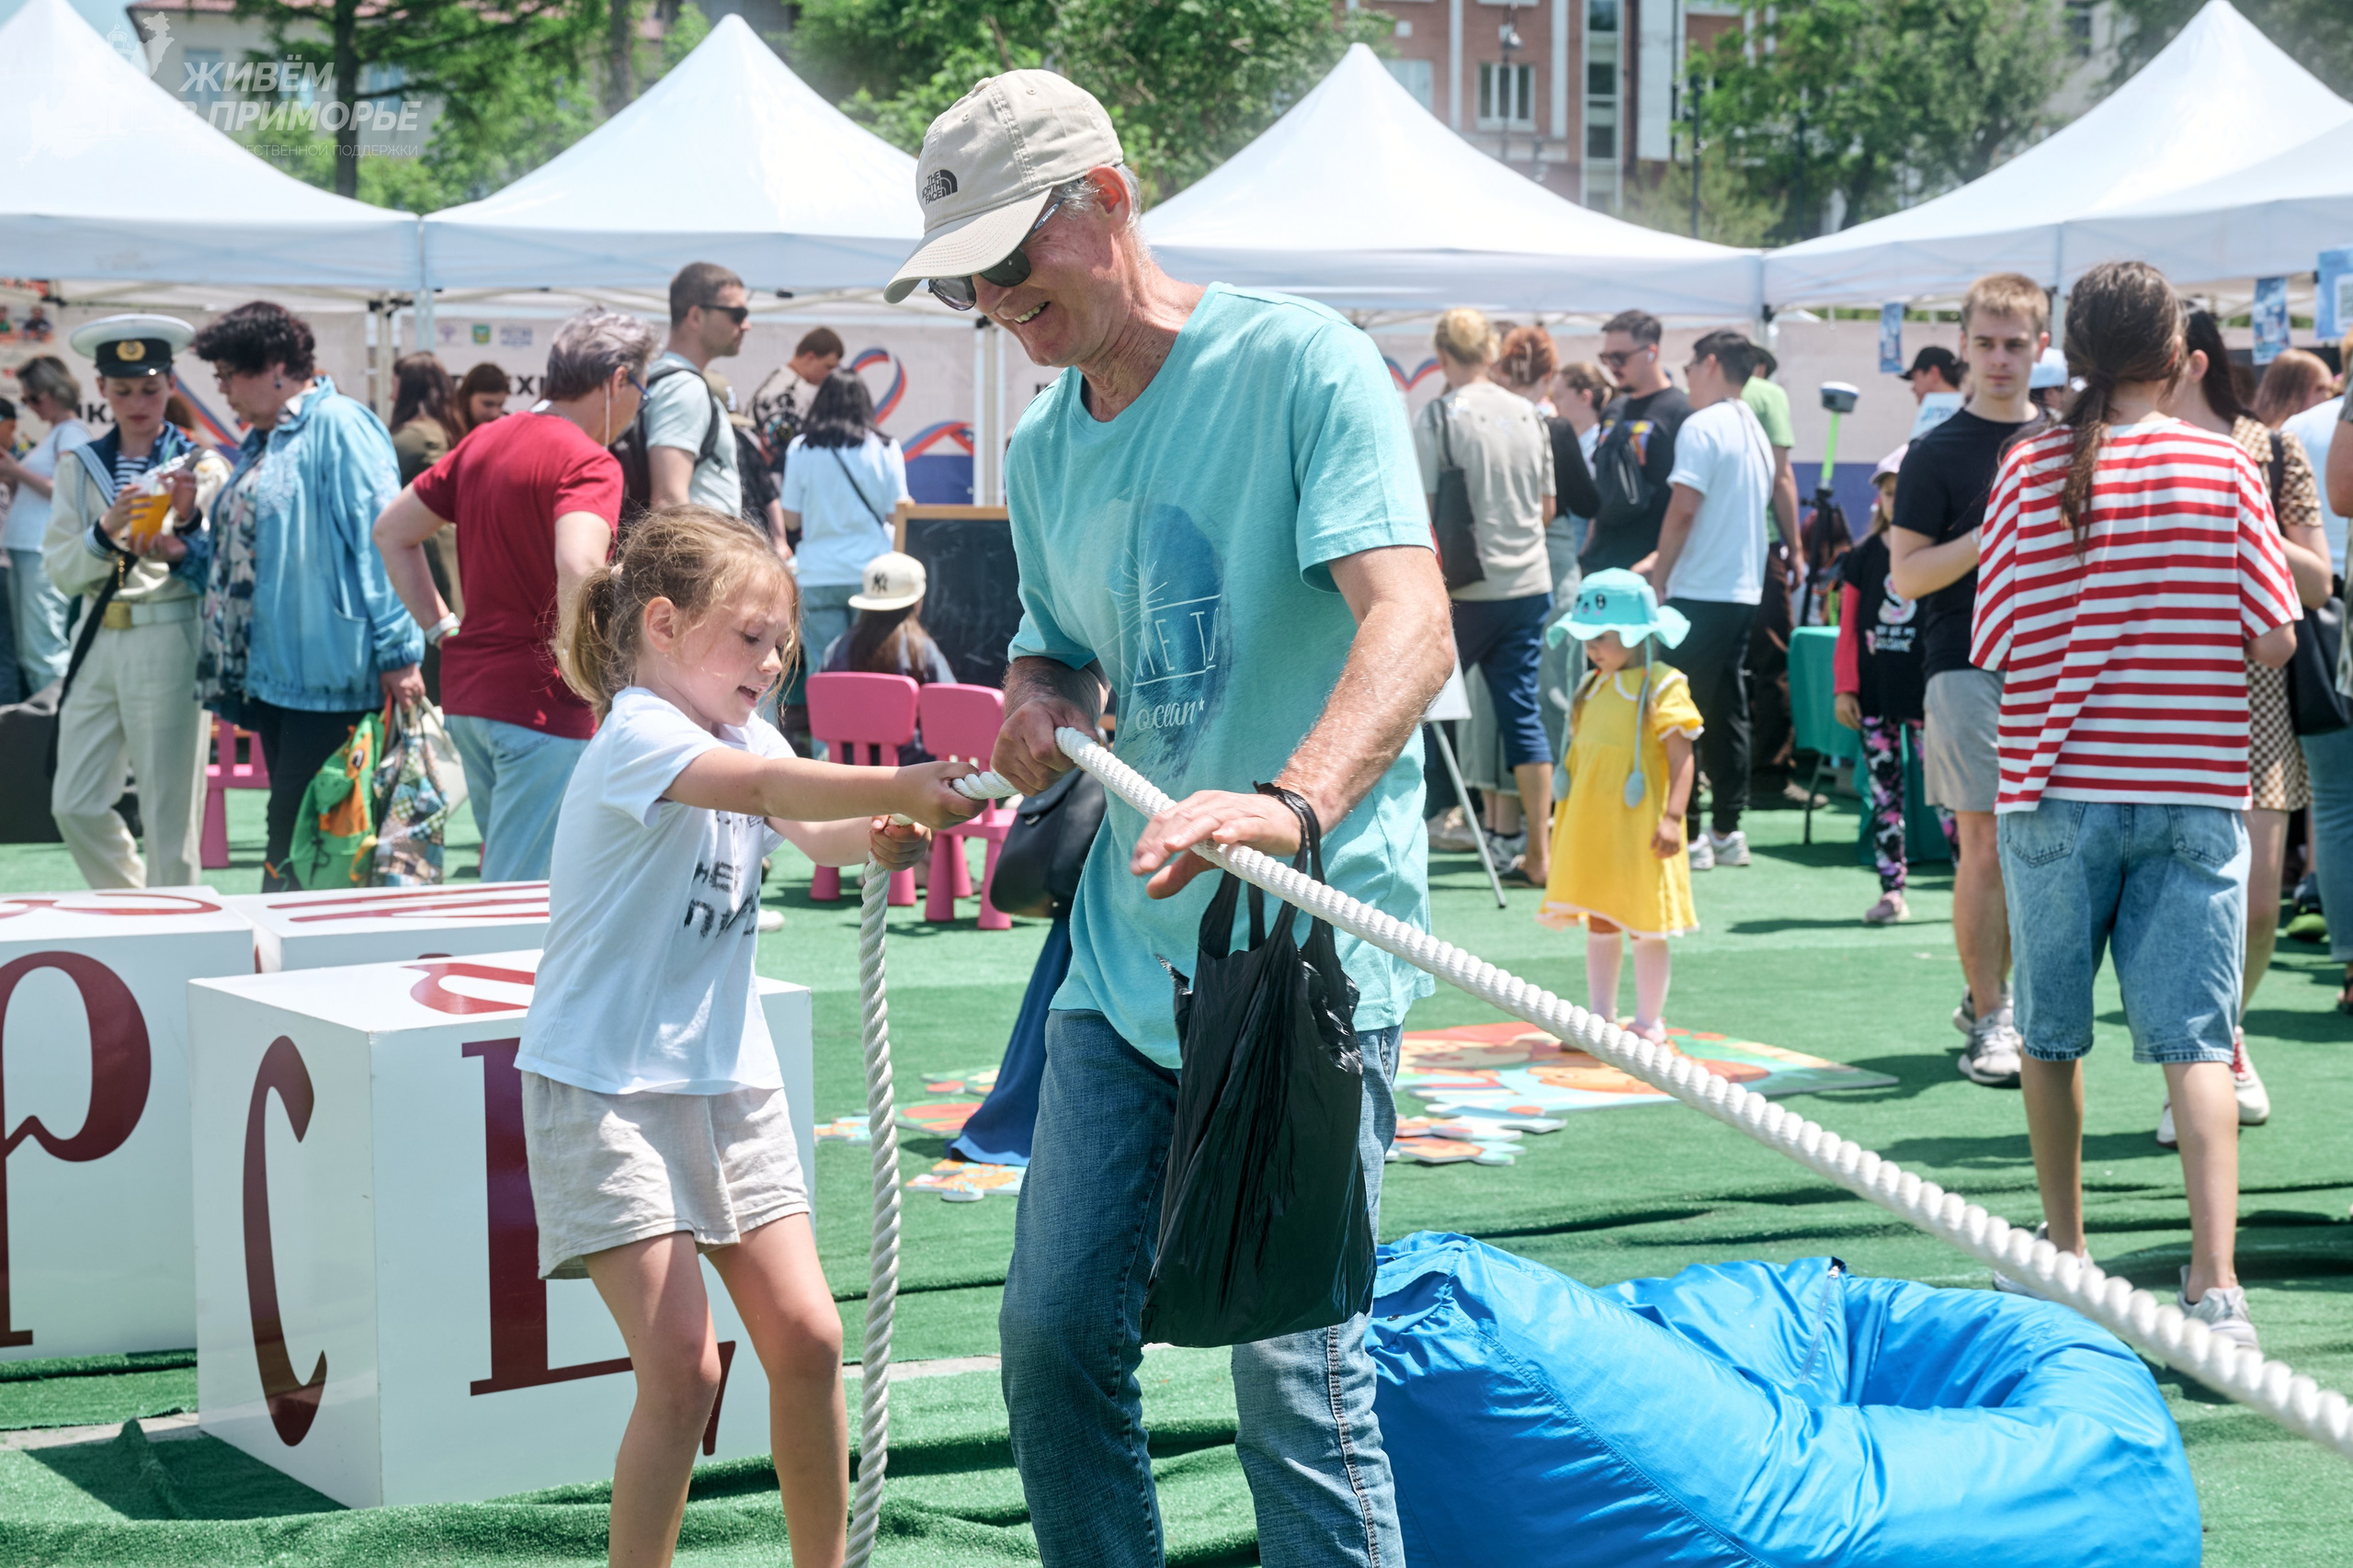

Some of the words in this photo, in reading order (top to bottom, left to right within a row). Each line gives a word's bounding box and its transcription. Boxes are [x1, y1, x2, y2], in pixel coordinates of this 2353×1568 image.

[927, 171, 939, 185] THE
[925, 188, 943, 205] FACE
[1135, 701, 1196, 730] ocean
